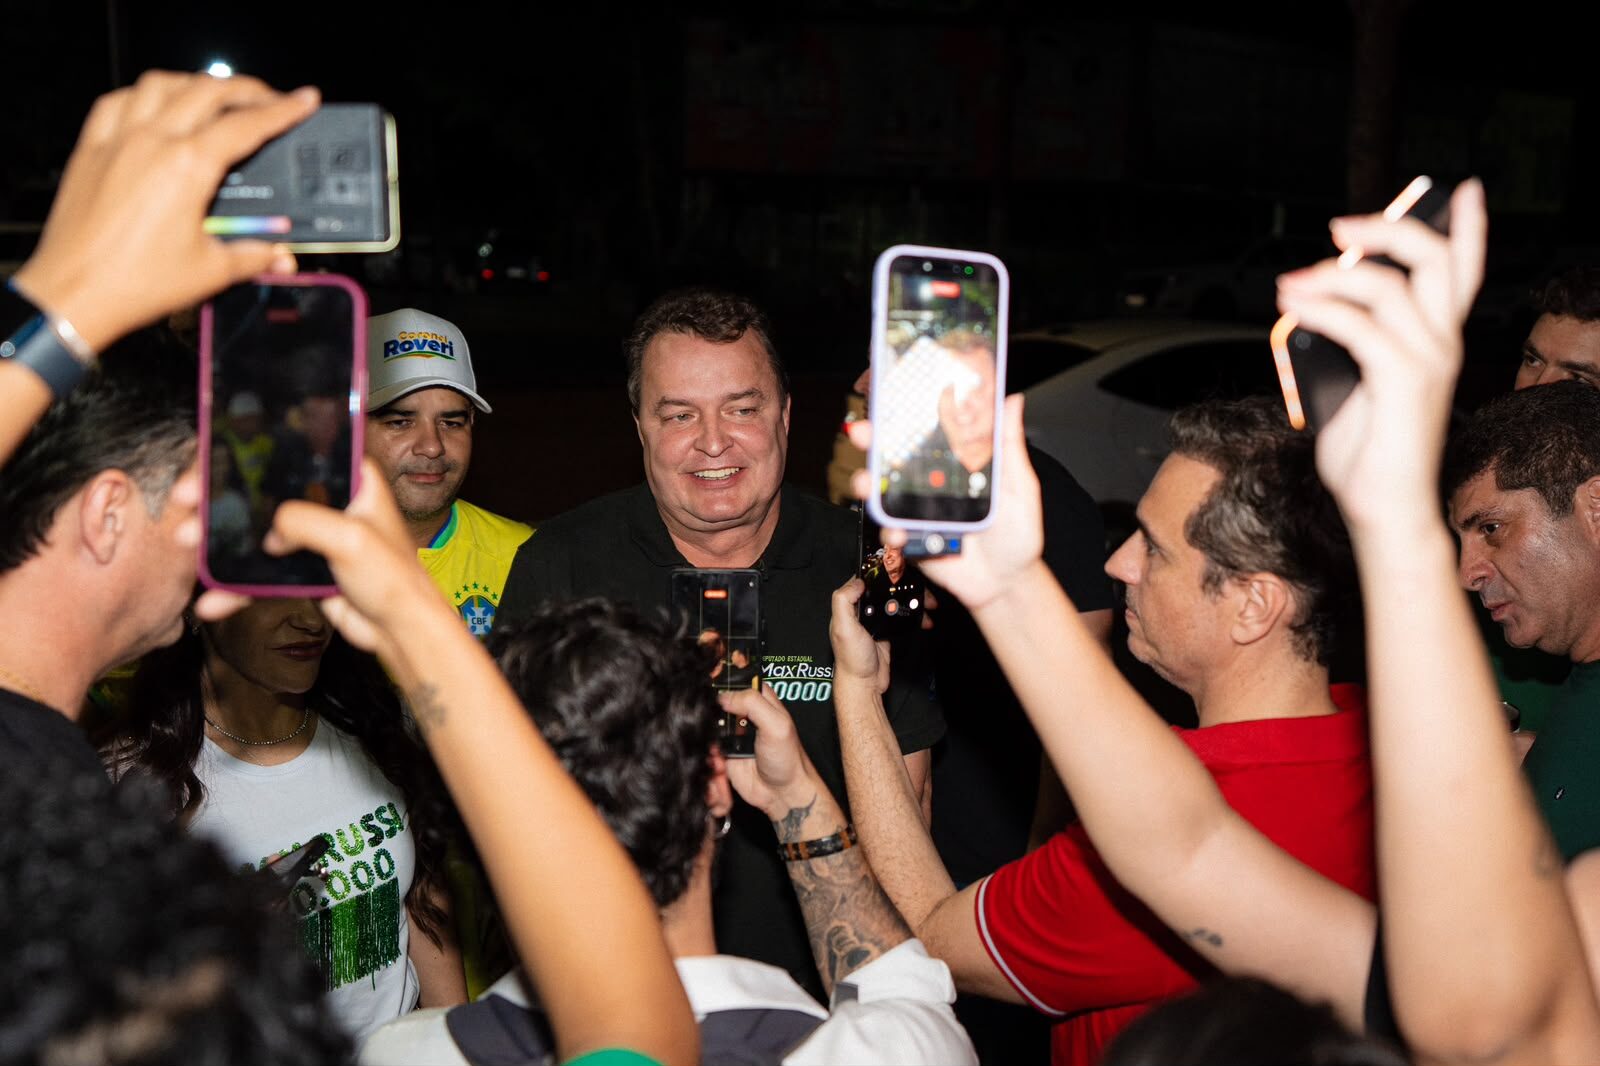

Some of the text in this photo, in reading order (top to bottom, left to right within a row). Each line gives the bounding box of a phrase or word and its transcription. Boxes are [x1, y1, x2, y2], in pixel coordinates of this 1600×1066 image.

[384, 339, 454, 358] Roveri
[471, 617, 487, 625] CBF
[764, 681, 832, 701] 0000
